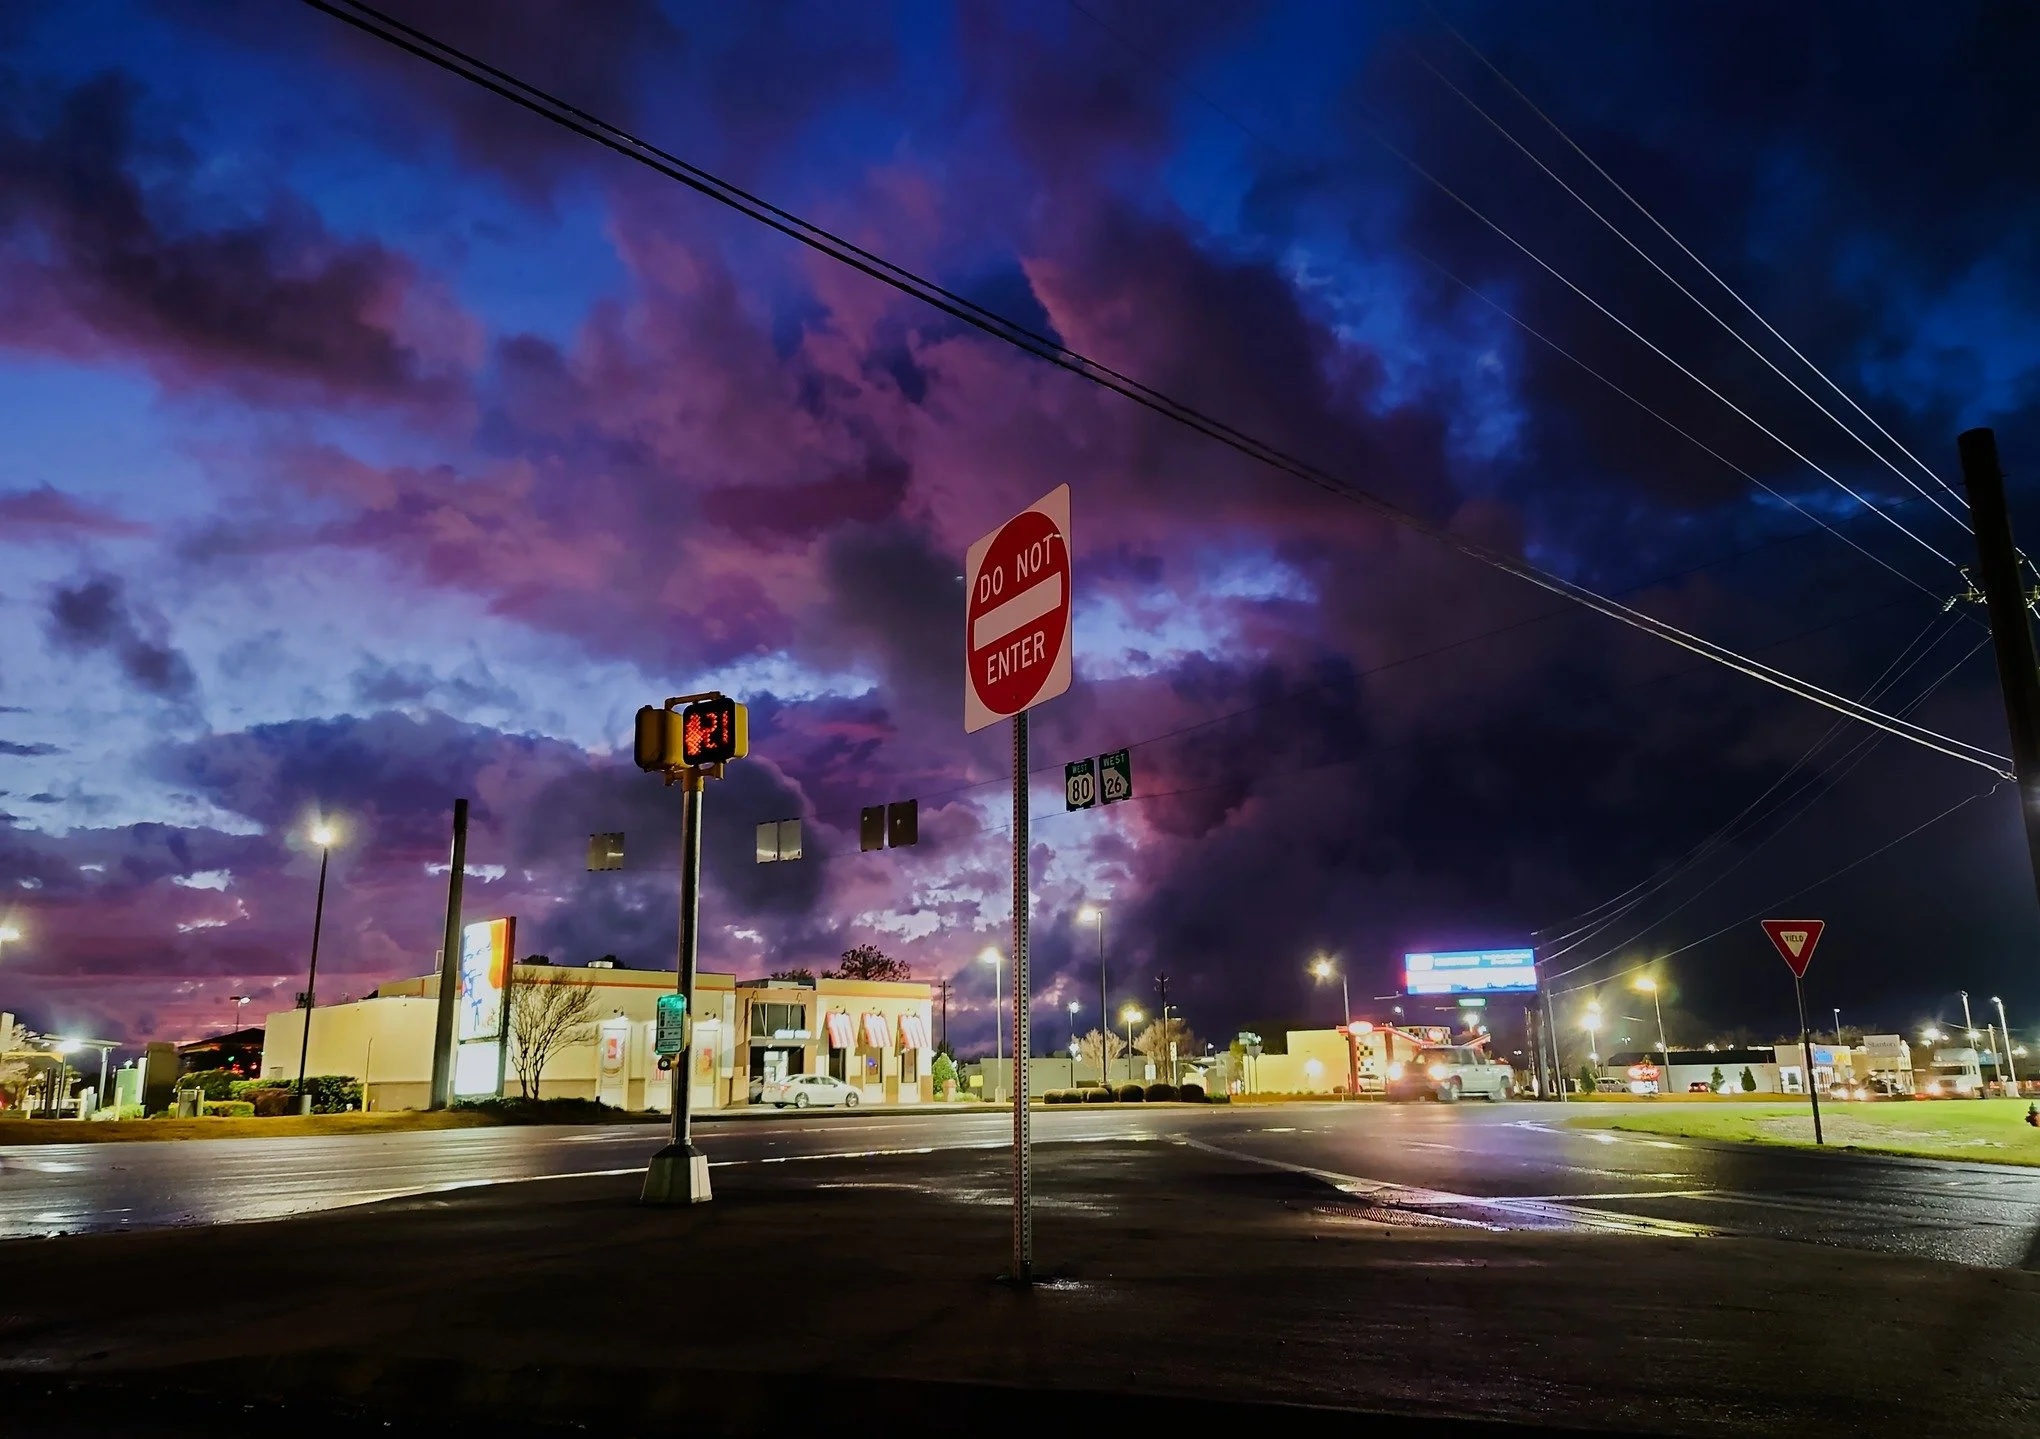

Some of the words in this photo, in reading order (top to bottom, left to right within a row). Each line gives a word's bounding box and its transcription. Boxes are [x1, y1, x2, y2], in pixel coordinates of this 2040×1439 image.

[980, 566, 1003, 604] DO
[1016, 532, 1055, 583] NOT
[987, 630, 1046, 685] ENTER
[1072, 763, 1088, 774] WEST
[1103, 753, 1126, 767] WEST
[1072, 777, 1090, 802] 80
[1106, 776, 1122, 796] 26
